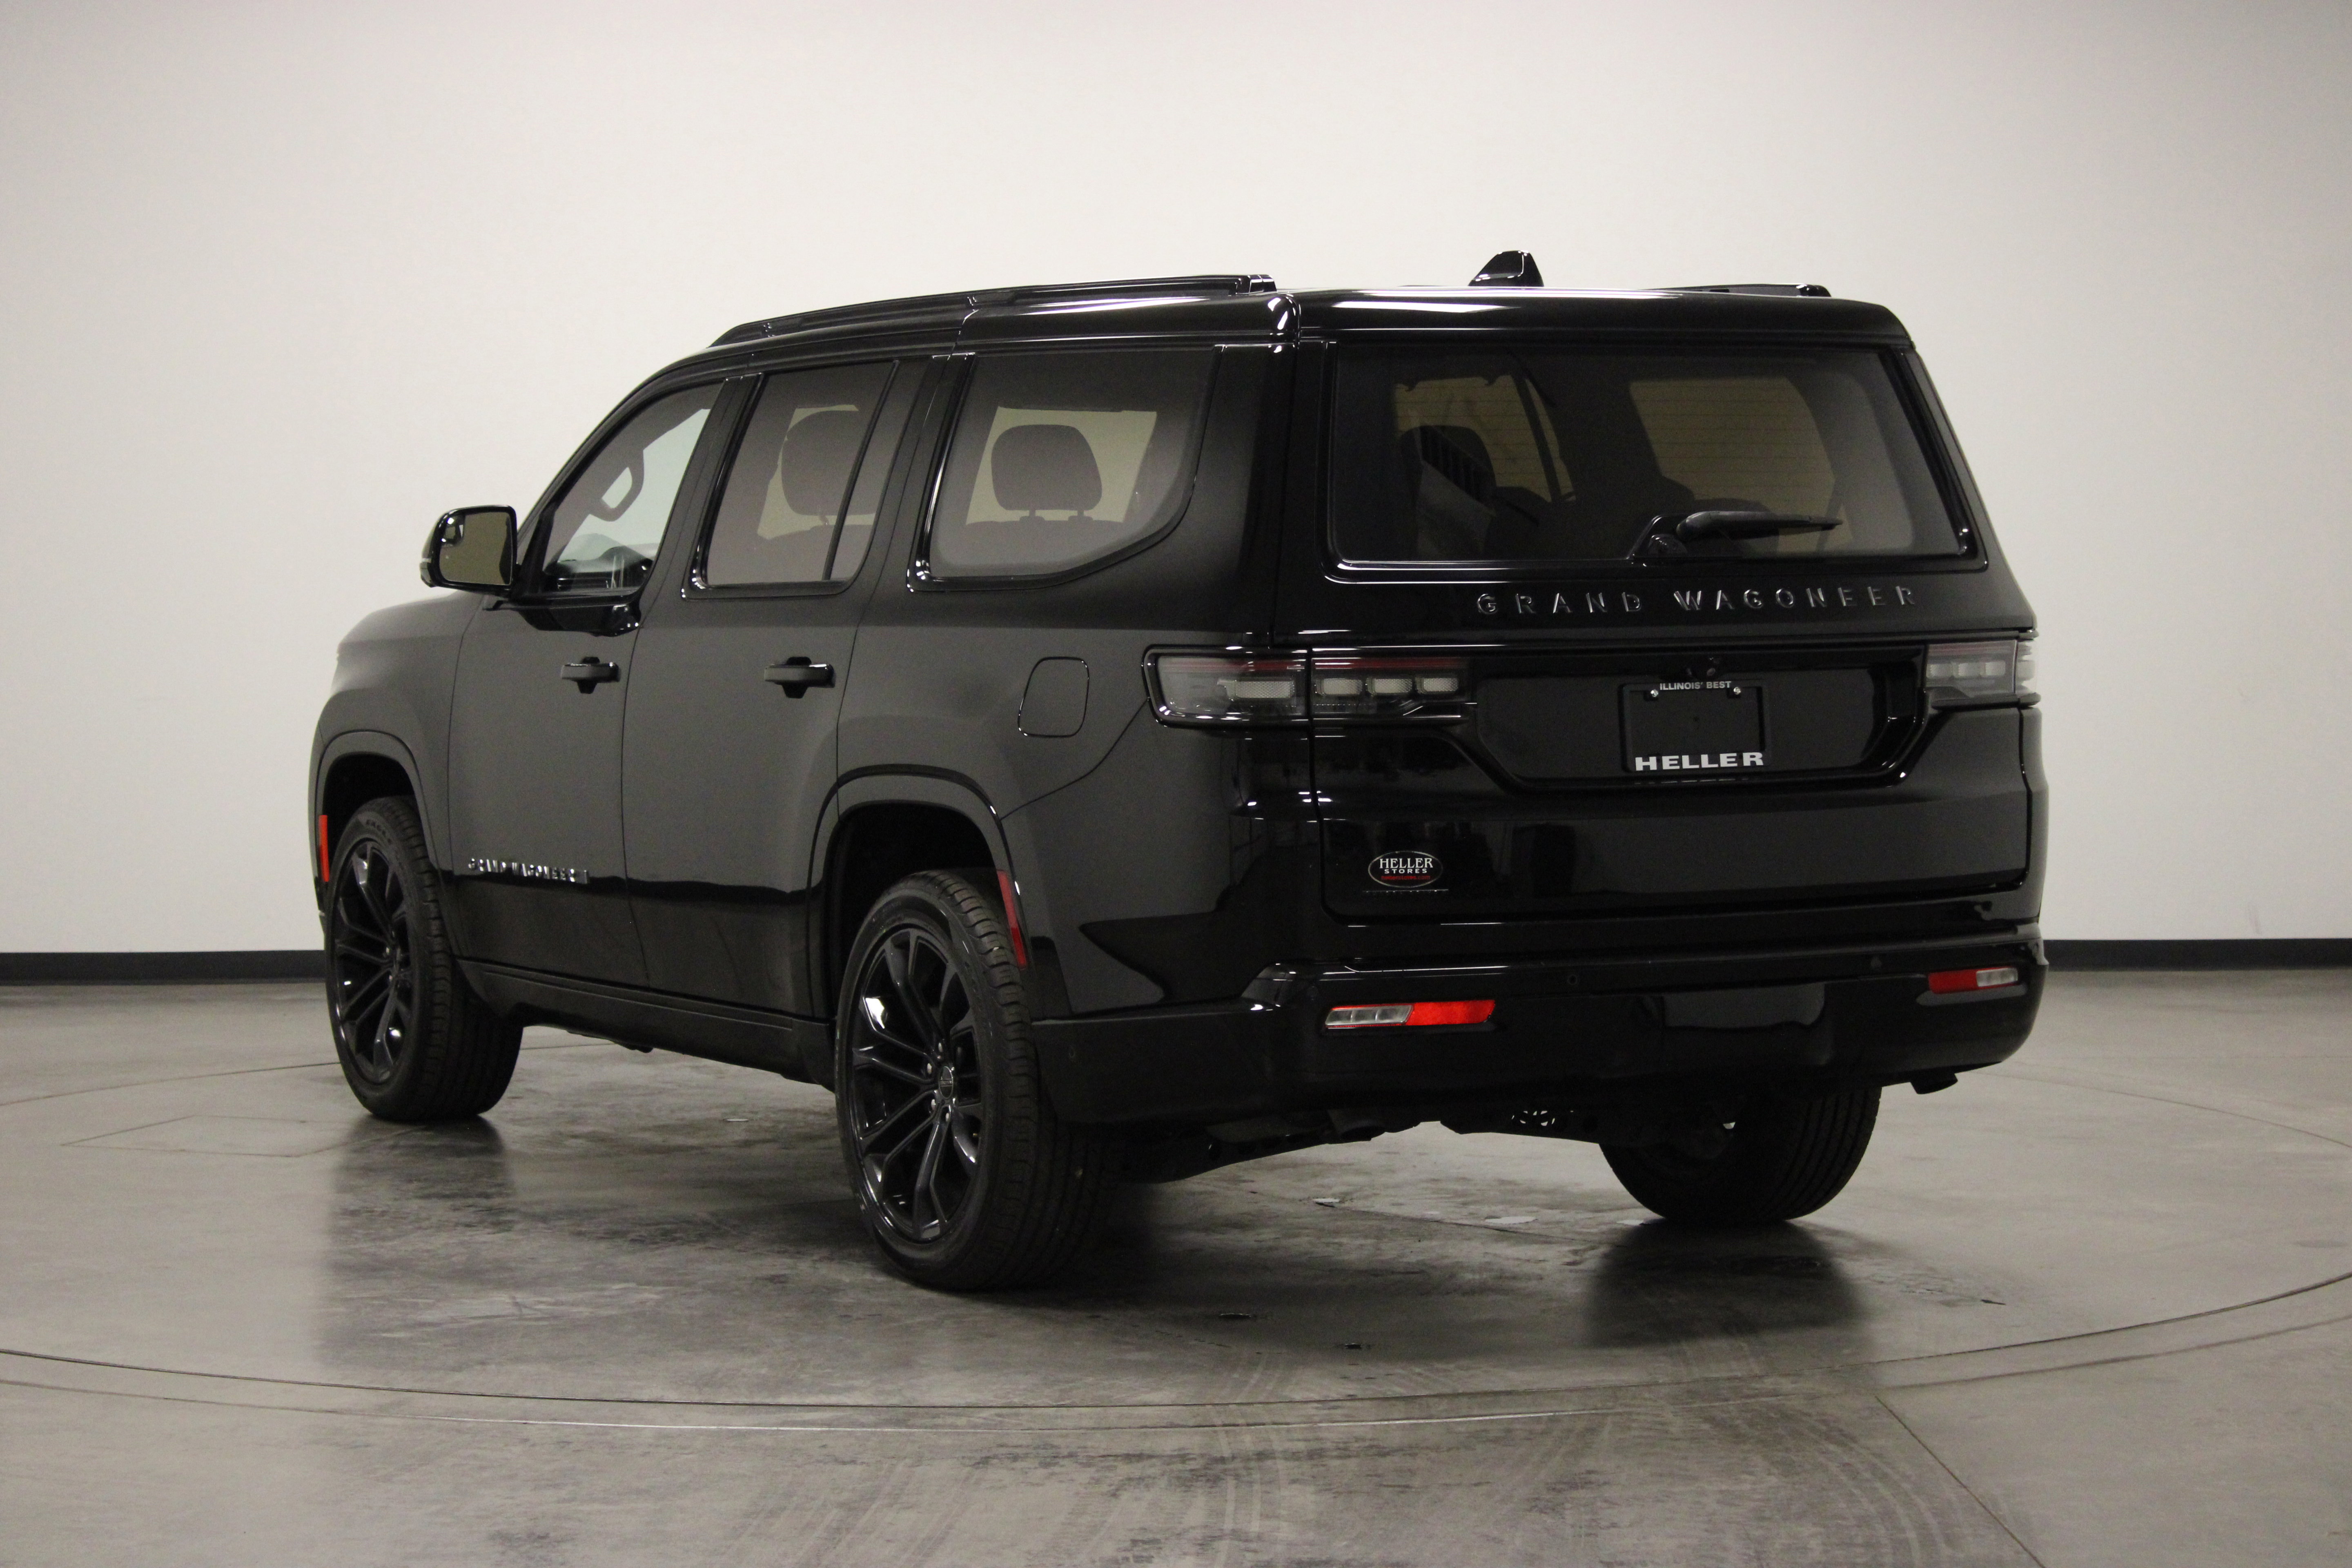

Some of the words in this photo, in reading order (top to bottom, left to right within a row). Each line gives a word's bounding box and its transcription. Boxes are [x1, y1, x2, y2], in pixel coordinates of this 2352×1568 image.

[1477, 591, 1643, 614] GRAND
[1673, 586, 1916, 611] WAGONEER
[1659, 682, 1703, 690] ILLINOIS'
[1706, 681, 1732, 689] BEST
[1635, 752, 1764, 771] HELLER
[1379, 858, 1433, 869] HELLER
